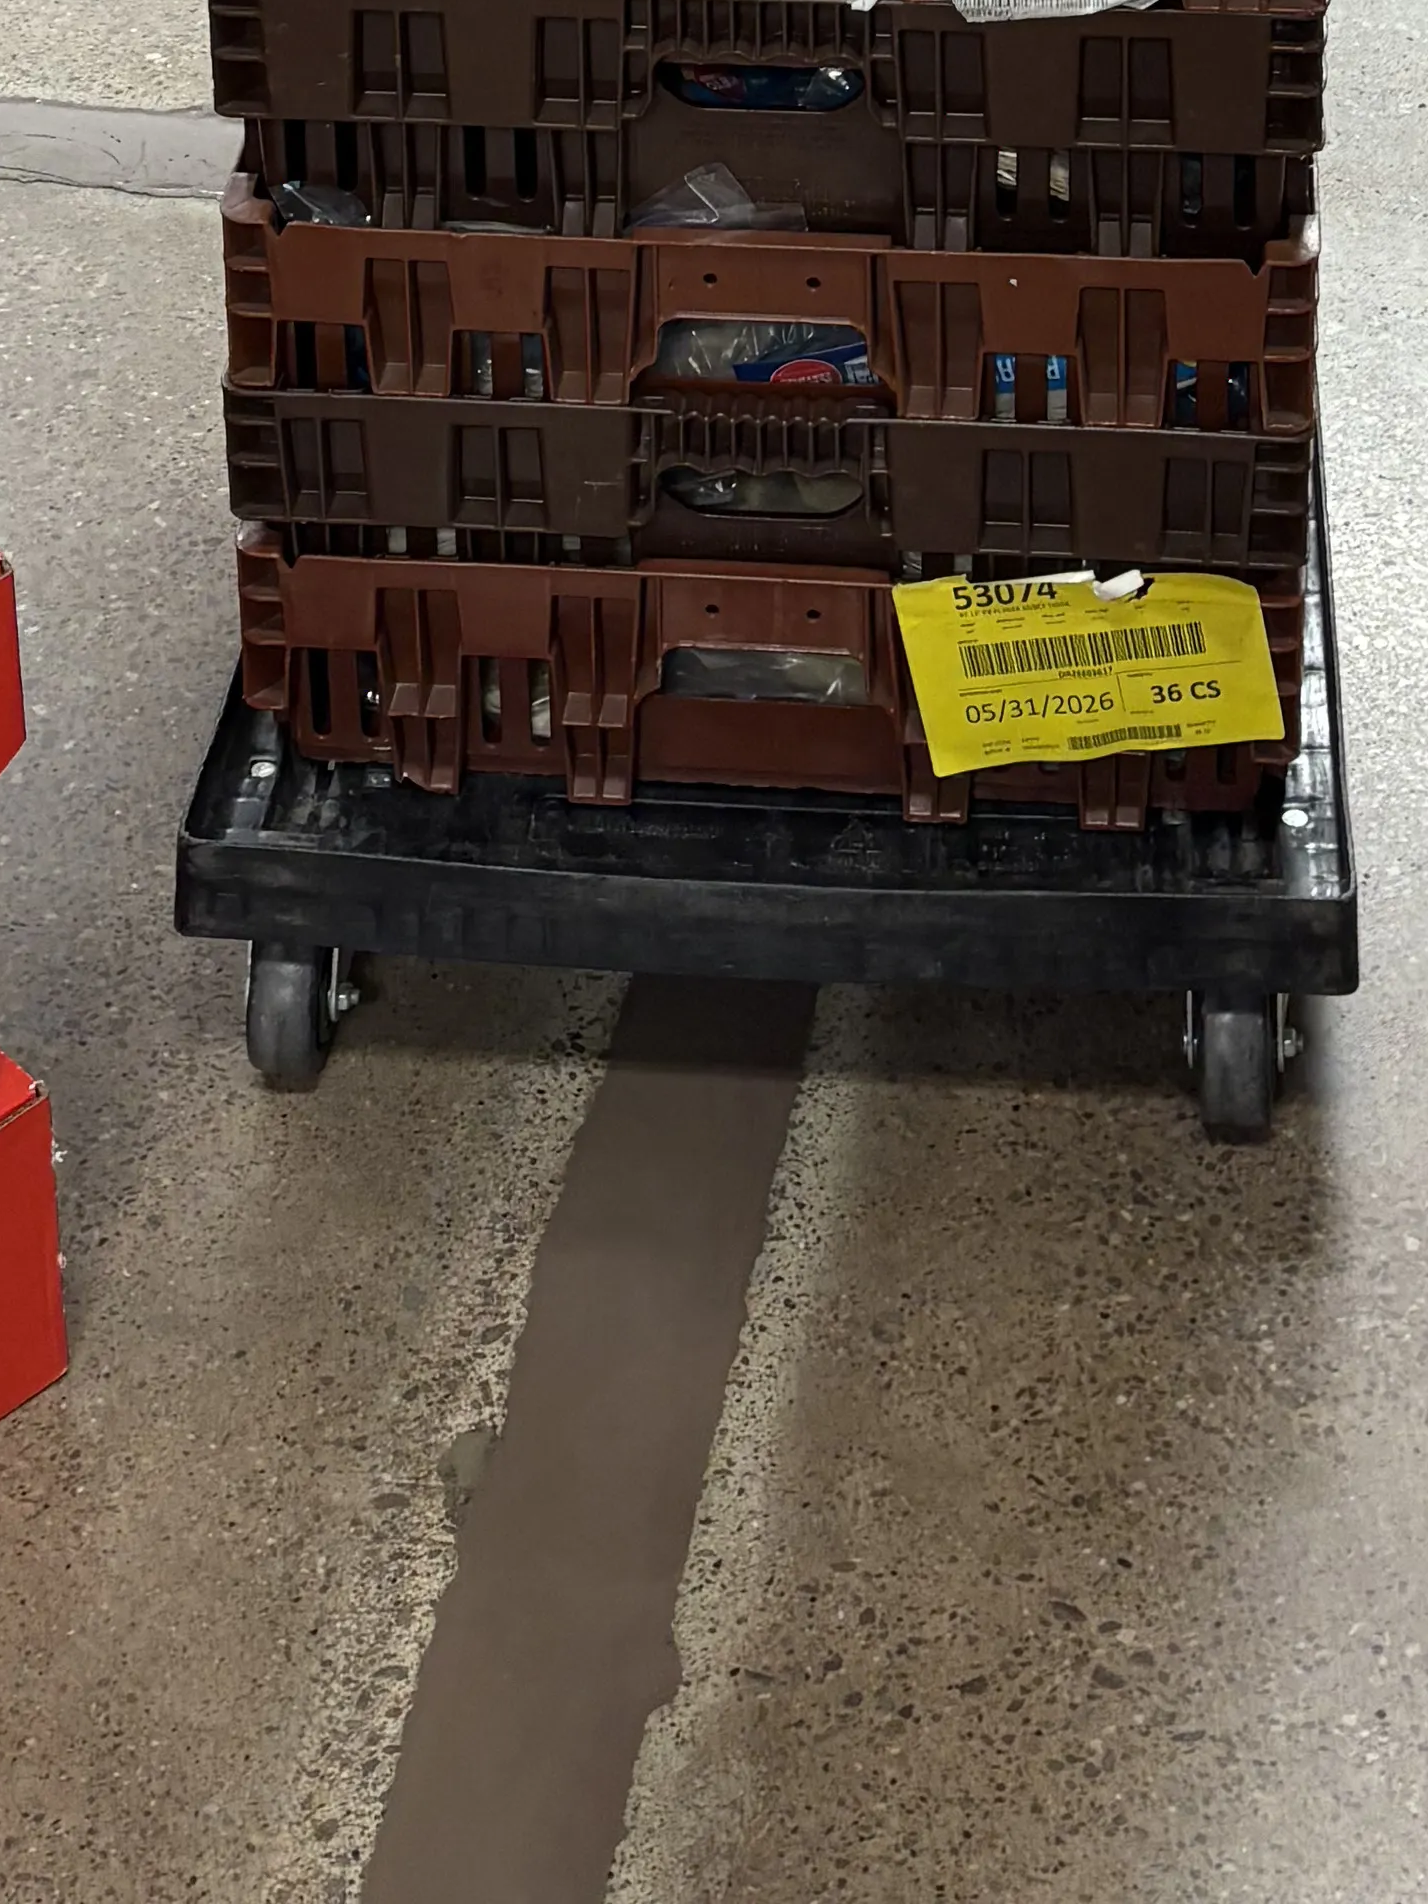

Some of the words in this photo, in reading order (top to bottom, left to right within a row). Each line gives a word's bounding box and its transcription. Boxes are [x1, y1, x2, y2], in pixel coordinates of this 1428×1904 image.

[952, 582, 1057, 612] 53074
[1150, 683, 1183, 705] 36
[1189, 679, 1222, 701] CS
[965, 690, 1115, 725] 05/31/2026
